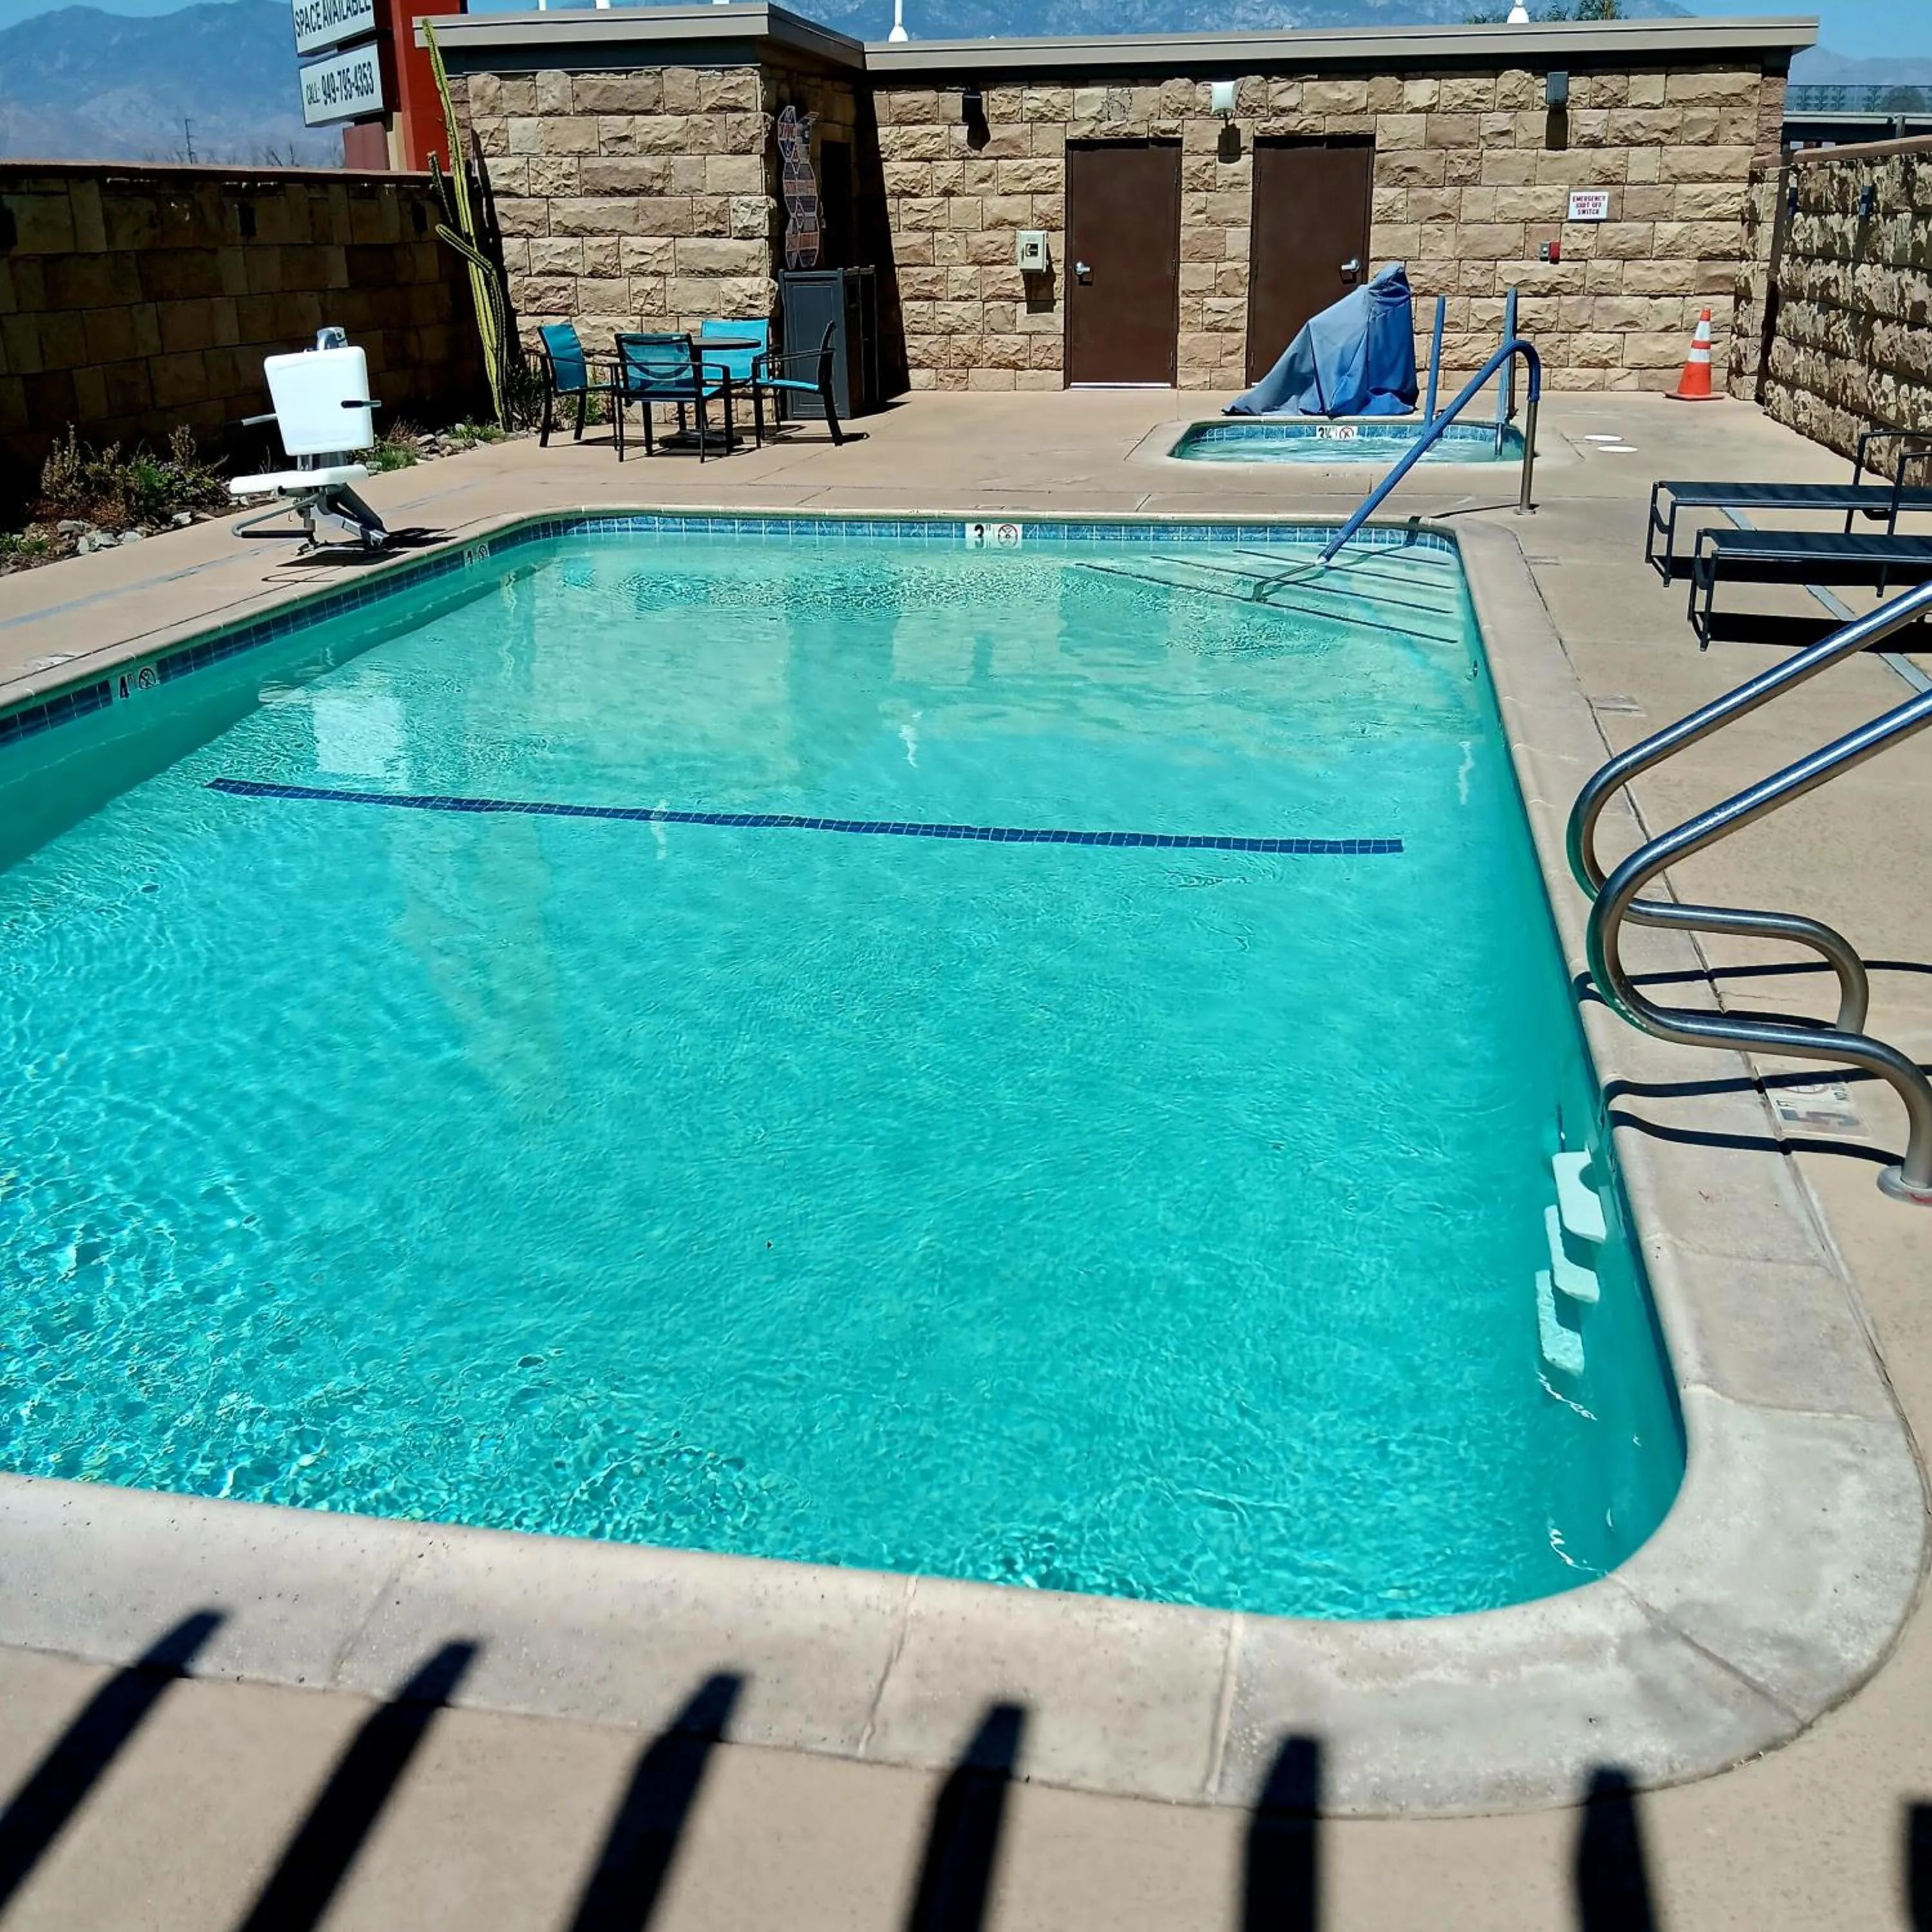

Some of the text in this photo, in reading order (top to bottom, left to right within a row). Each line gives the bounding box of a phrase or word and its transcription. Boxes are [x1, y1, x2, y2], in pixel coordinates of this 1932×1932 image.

[295, 2, 322, 38] SPACE
[306, 61, 374, 106] CALL: 949-795-4353
[120, 676, 129, 699] 4
